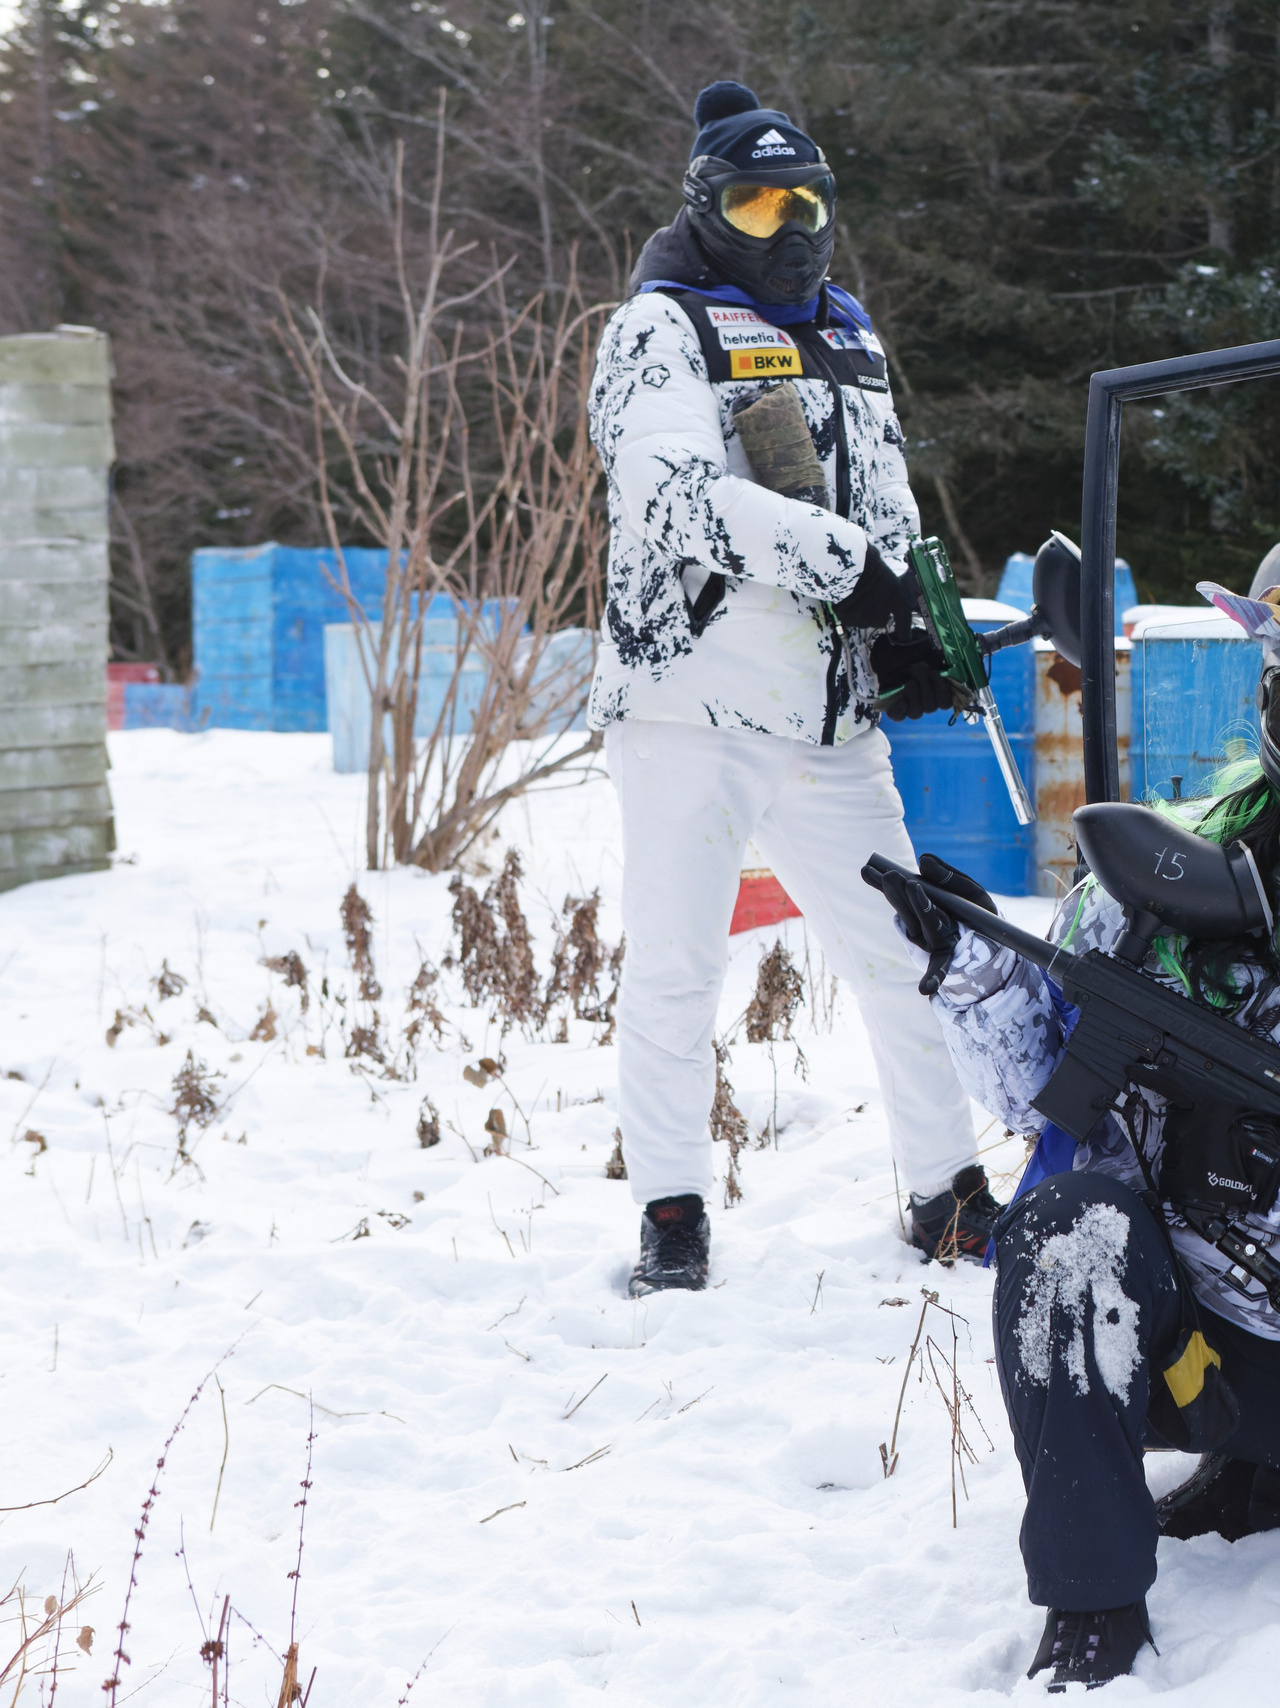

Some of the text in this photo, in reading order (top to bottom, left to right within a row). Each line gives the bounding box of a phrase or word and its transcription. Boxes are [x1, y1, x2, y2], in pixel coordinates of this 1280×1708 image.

[751, 144, 796, 158] adidas
[723, 332, 775, 345] helvetia
[754, 355, 793, 369] BKW
[1154, 846, 1187, 880] 15
